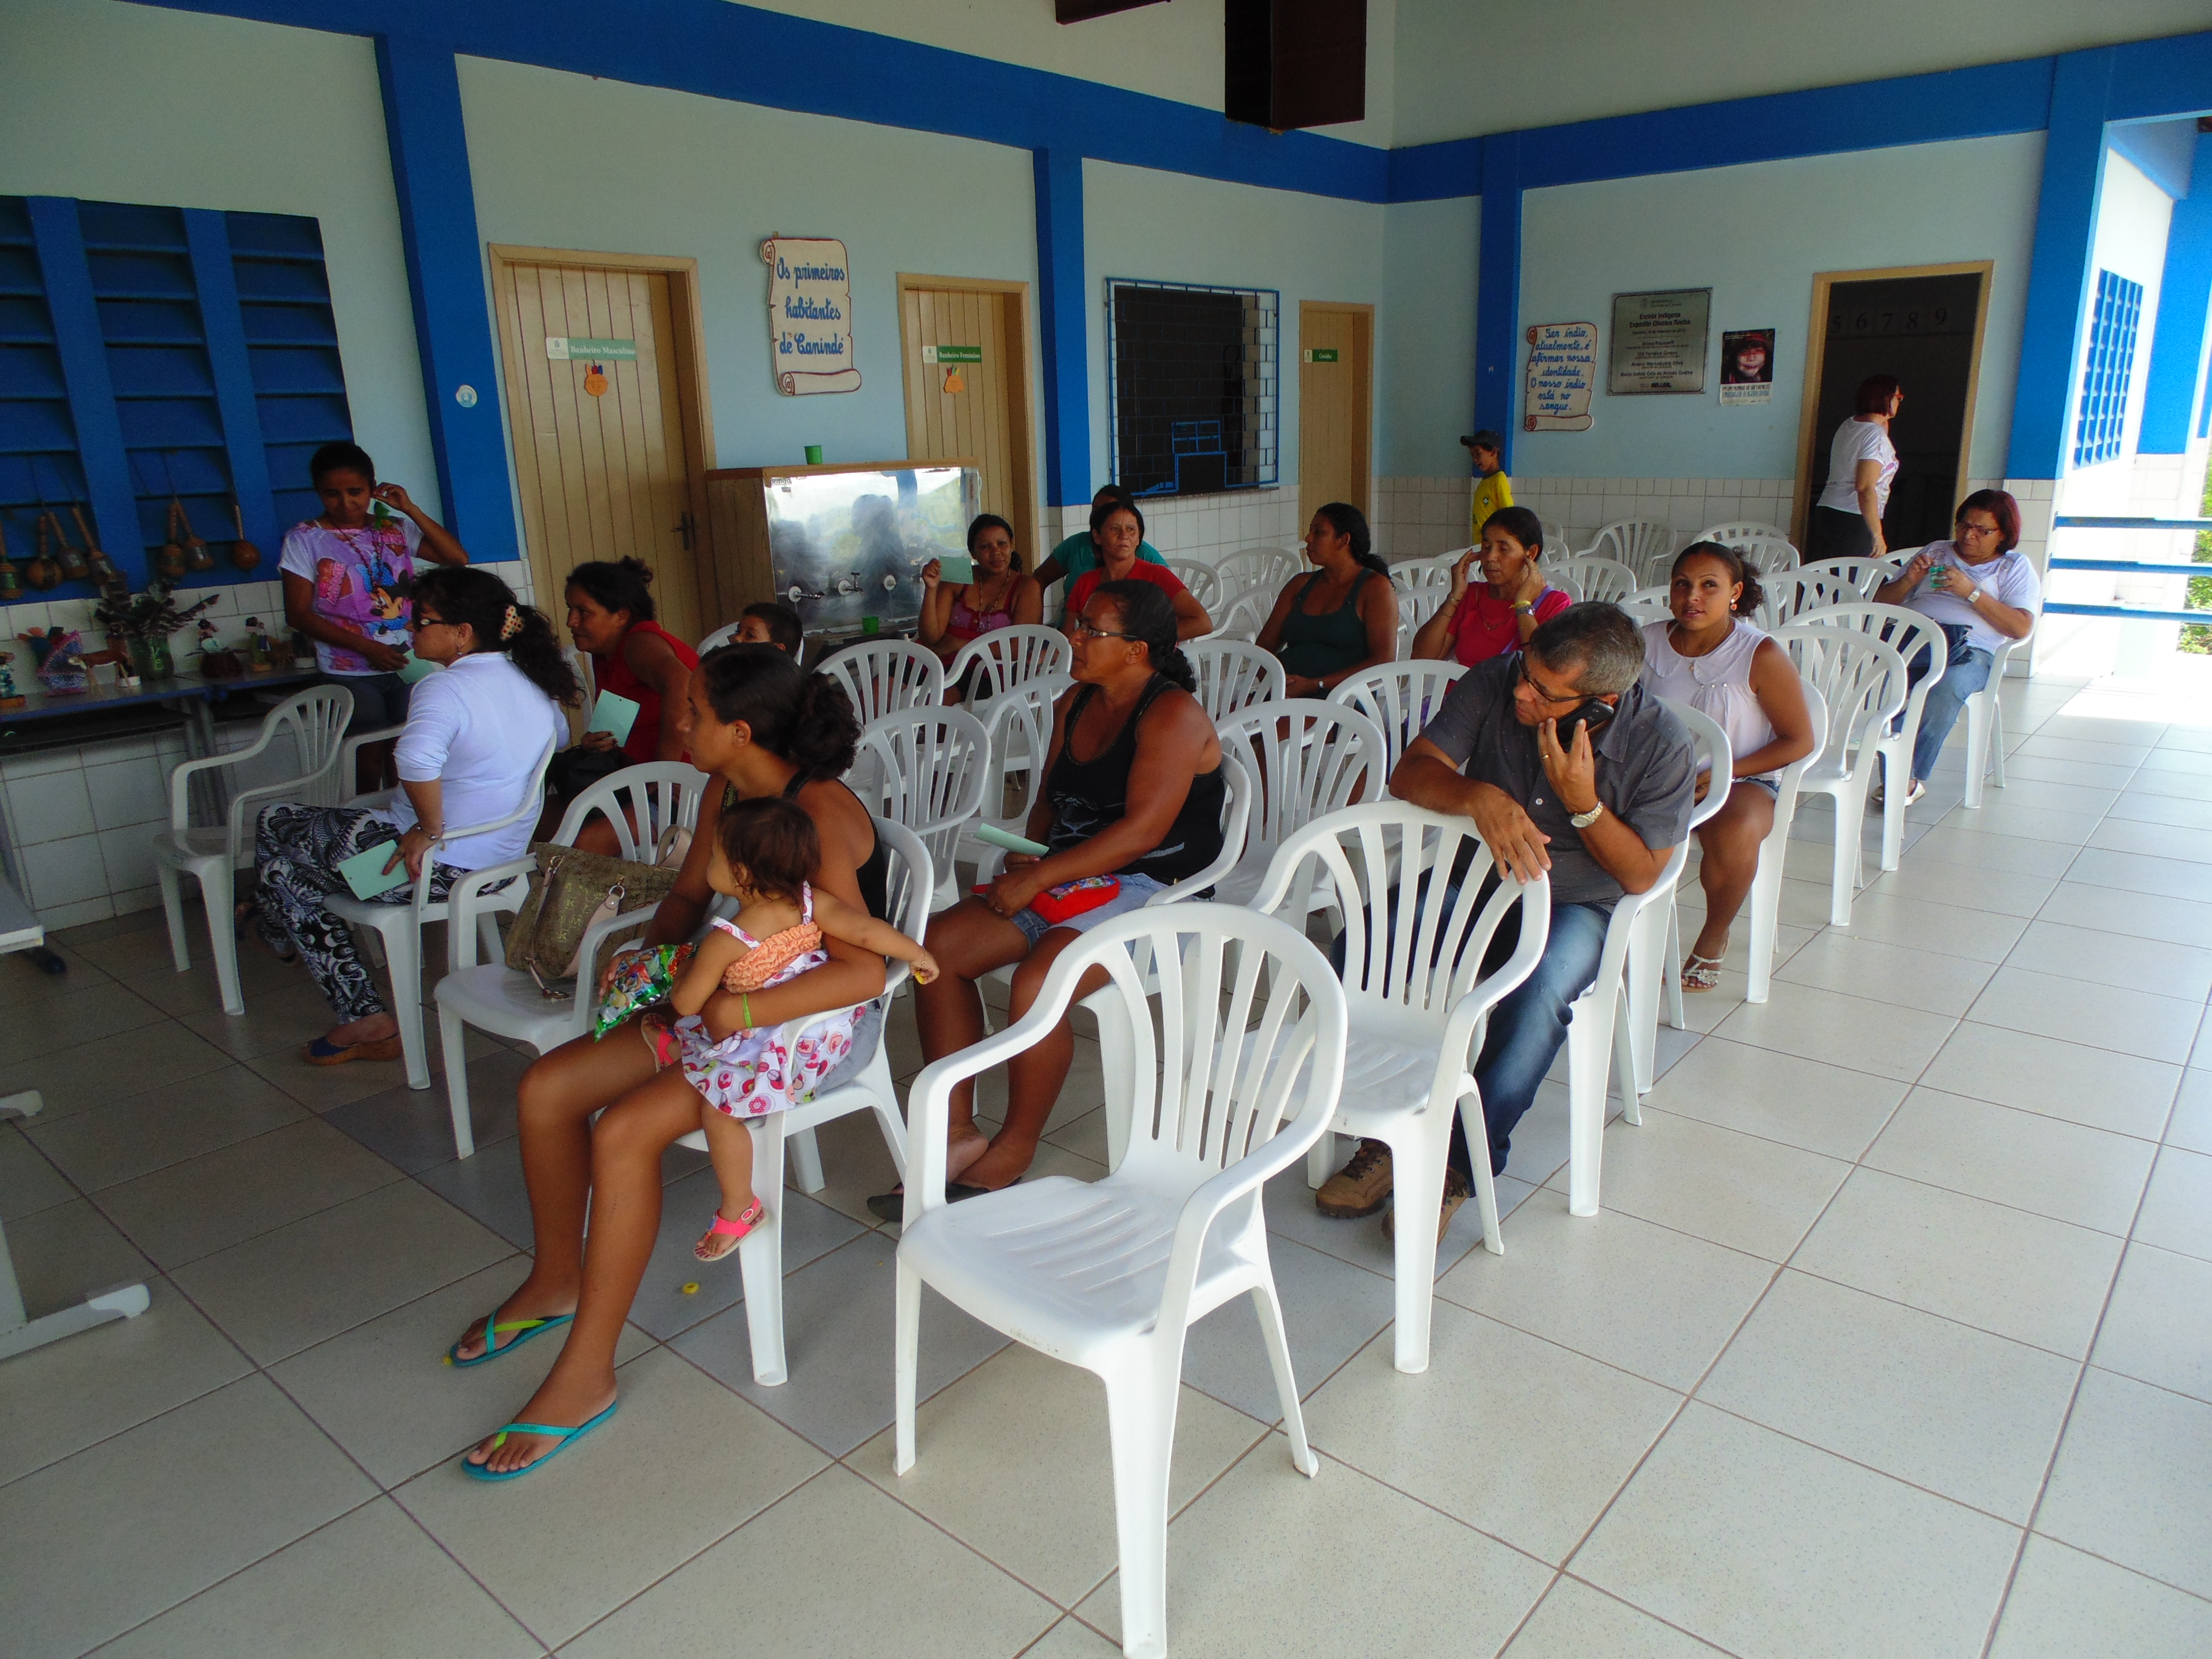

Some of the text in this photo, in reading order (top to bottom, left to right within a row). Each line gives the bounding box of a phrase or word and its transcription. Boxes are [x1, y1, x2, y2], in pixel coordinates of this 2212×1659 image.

[777, 256, 846, 289] Os primeiros
[785, 295, 841, 320] habitantes
[1831, 308, 1947, 333] 5 6 7 8 9
[1545, 326, 1588, 338] Ser índio,
[780, 332, 844, 355] de Canindé
[1536, 339, 1592, 351] atualmente, é
[570, 346, 601, 354] Banheiro
[602, 346, 636, 355] Masculino
[1531, 353, 1564, 367] afirmar
[1541, 366, 1584, 377] identidade.
[1531, 377, 1586, 389] O nosso índio
[1537, 390, 1555, 401] está
[1539, 402, 1572, 415] sangue.
